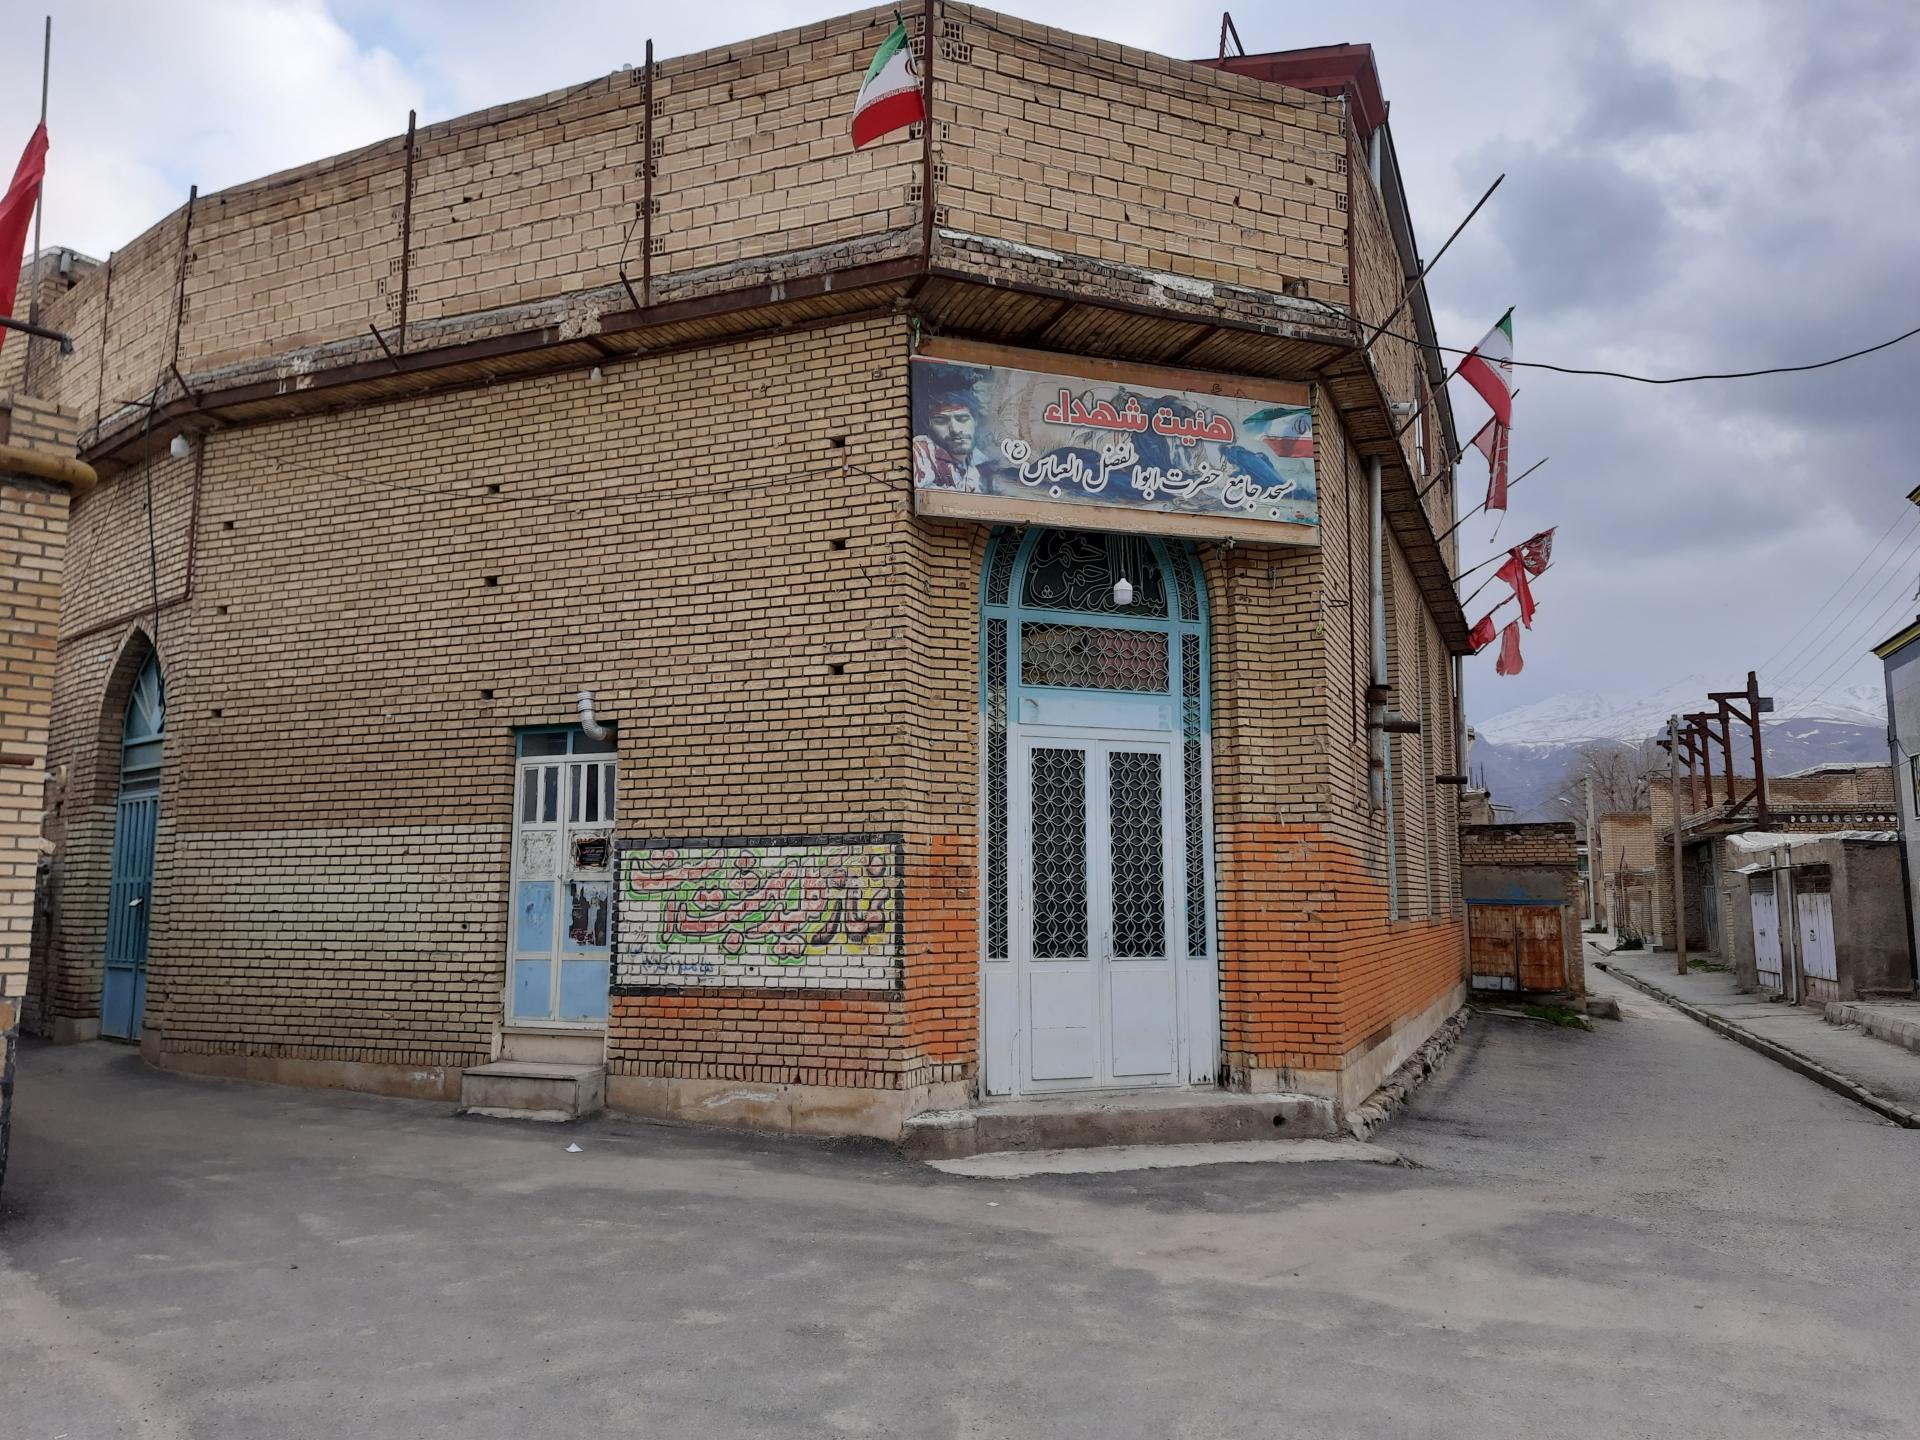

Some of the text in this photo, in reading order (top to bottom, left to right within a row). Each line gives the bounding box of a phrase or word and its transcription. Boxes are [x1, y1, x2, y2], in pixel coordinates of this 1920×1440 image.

[1044, 388, 1235, 446] هئیت شهداء
[1019, 453, 1082, 499] العباس
[1162, 463, 1221, 498] حضرت
[1221, 473, 1262, 512] جامع
[1263, 479, 1296, 518] مسجد
